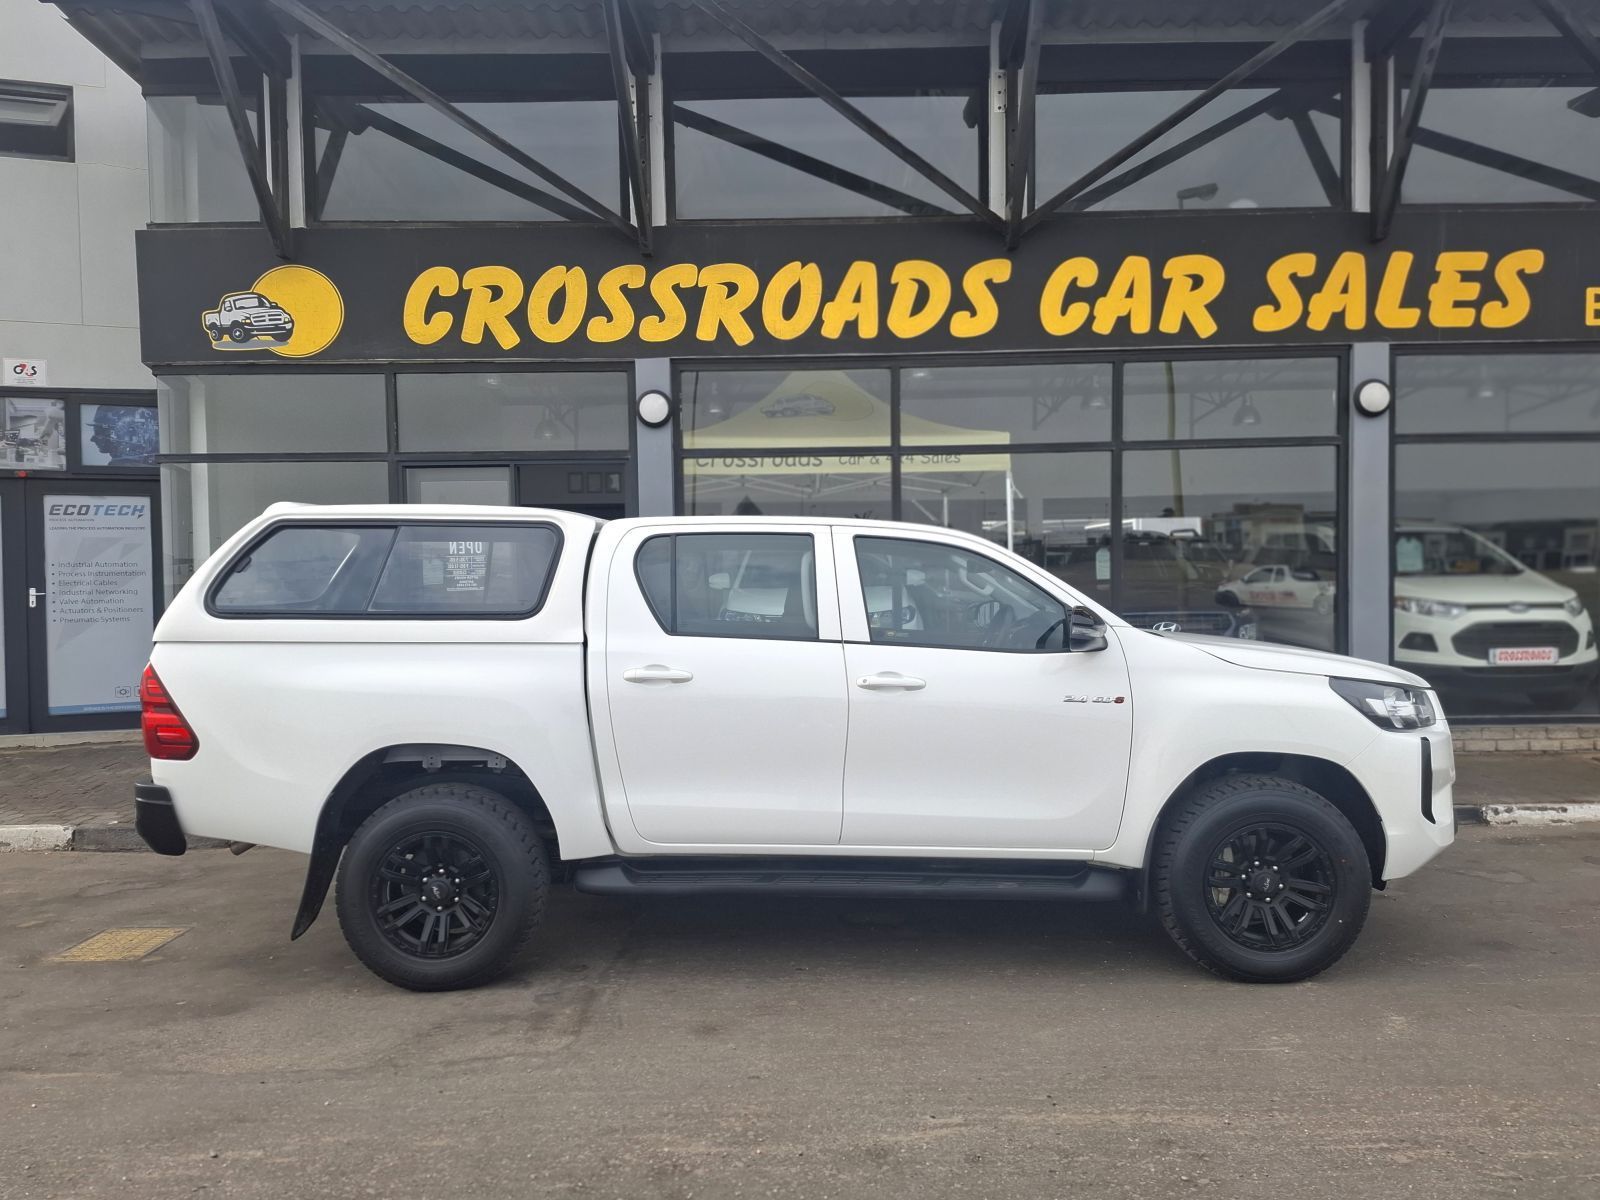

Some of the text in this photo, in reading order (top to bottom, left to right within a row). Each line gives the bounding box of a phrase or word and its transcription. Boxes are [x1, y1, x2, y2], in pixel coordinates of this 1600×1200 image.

[403, 249, 1545, 350] CROSSROADS CAR SALES
[48, 504, 145, 518] ECOTECH
[88, 569, 147, 577] Instrumentation
[95, 588, 138, 597] Networking
[100, 616, 131, 624] Systems
